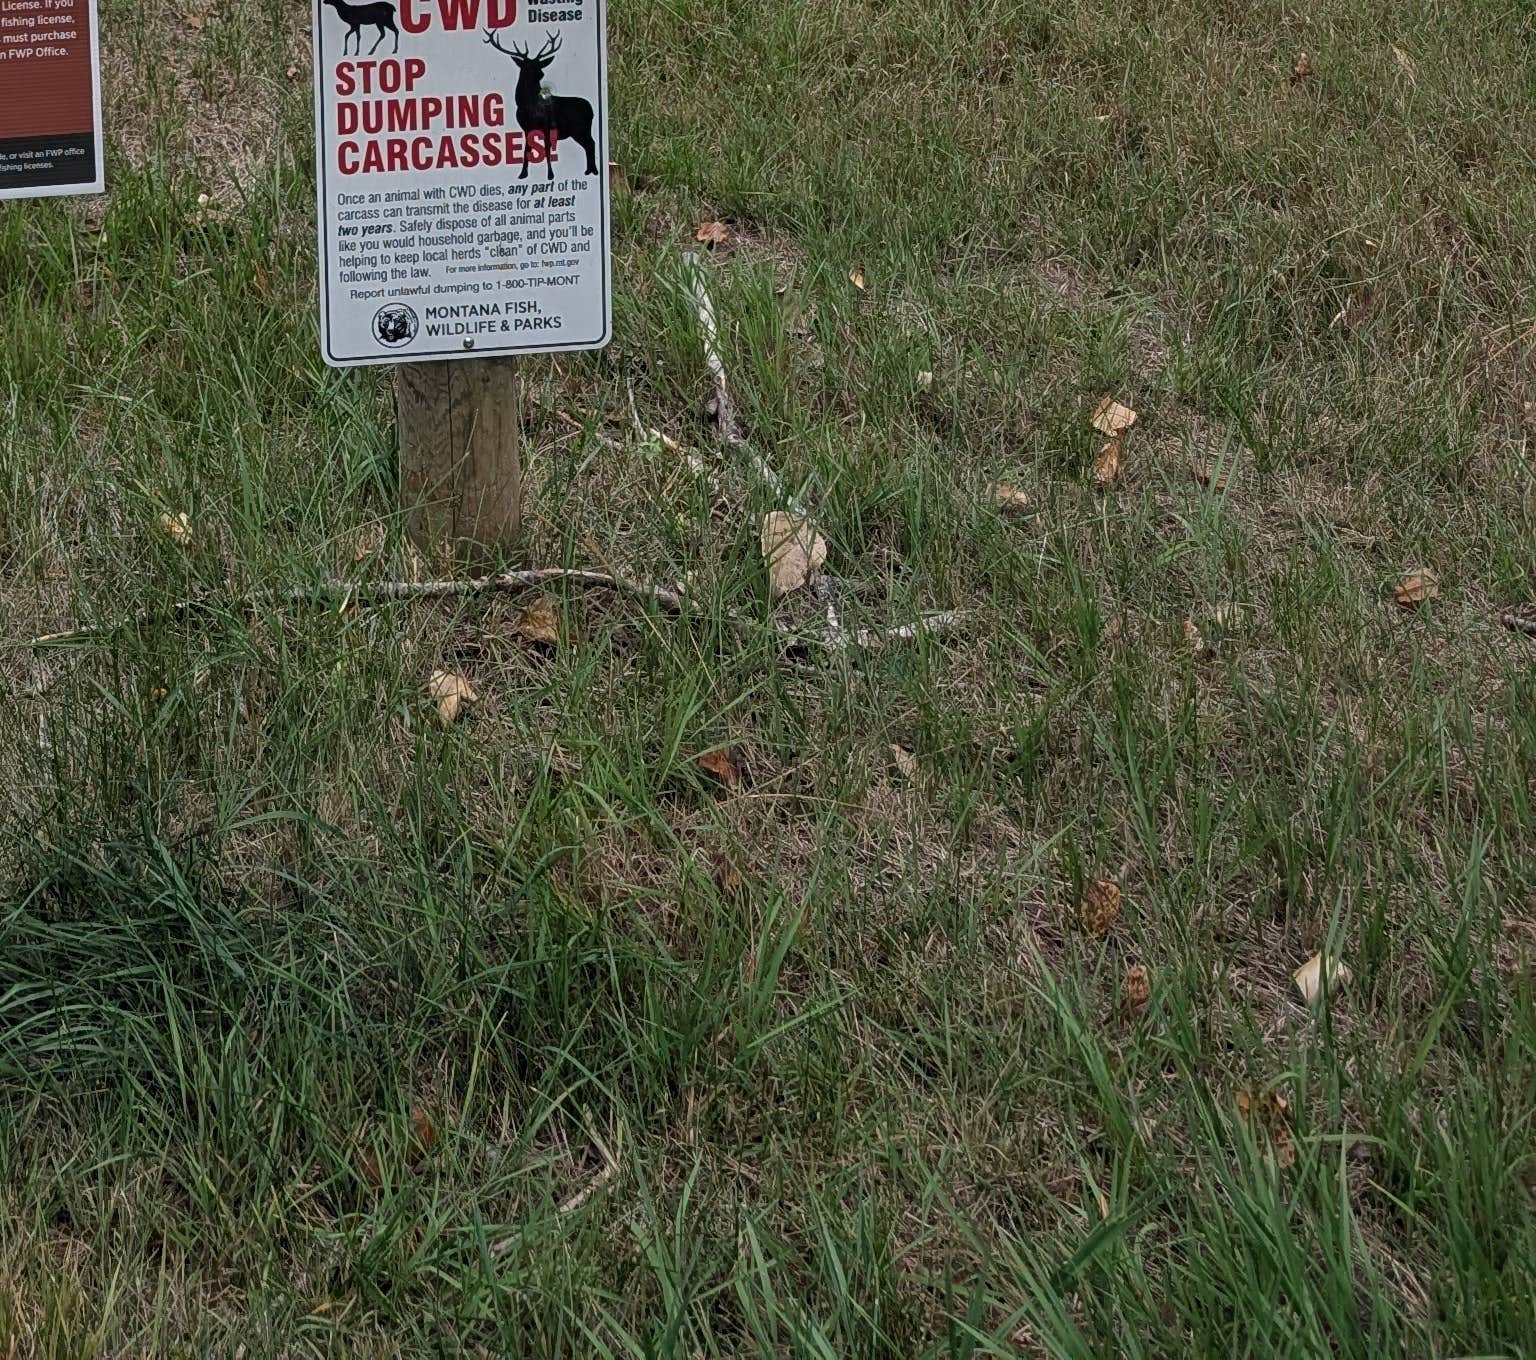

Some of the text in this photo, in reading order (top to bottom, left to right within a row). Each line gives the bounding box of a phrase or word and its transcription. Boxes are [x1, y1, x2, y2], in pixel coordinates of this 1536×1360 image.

[527, 8, 583, 24] Disease
[335, 59, 426, 95] STOP
[337, 93, 505, 135] DUMPING
[338, 129, 558, 174] CARCASSES!
[350, 274, 581, 301] Report unlawful dumping to 1-800-TIP-MONT
[425, 300, 542, 320] MONTANA FISH,
[425, 315, 562, 337] WILDLIFE & PARKS
